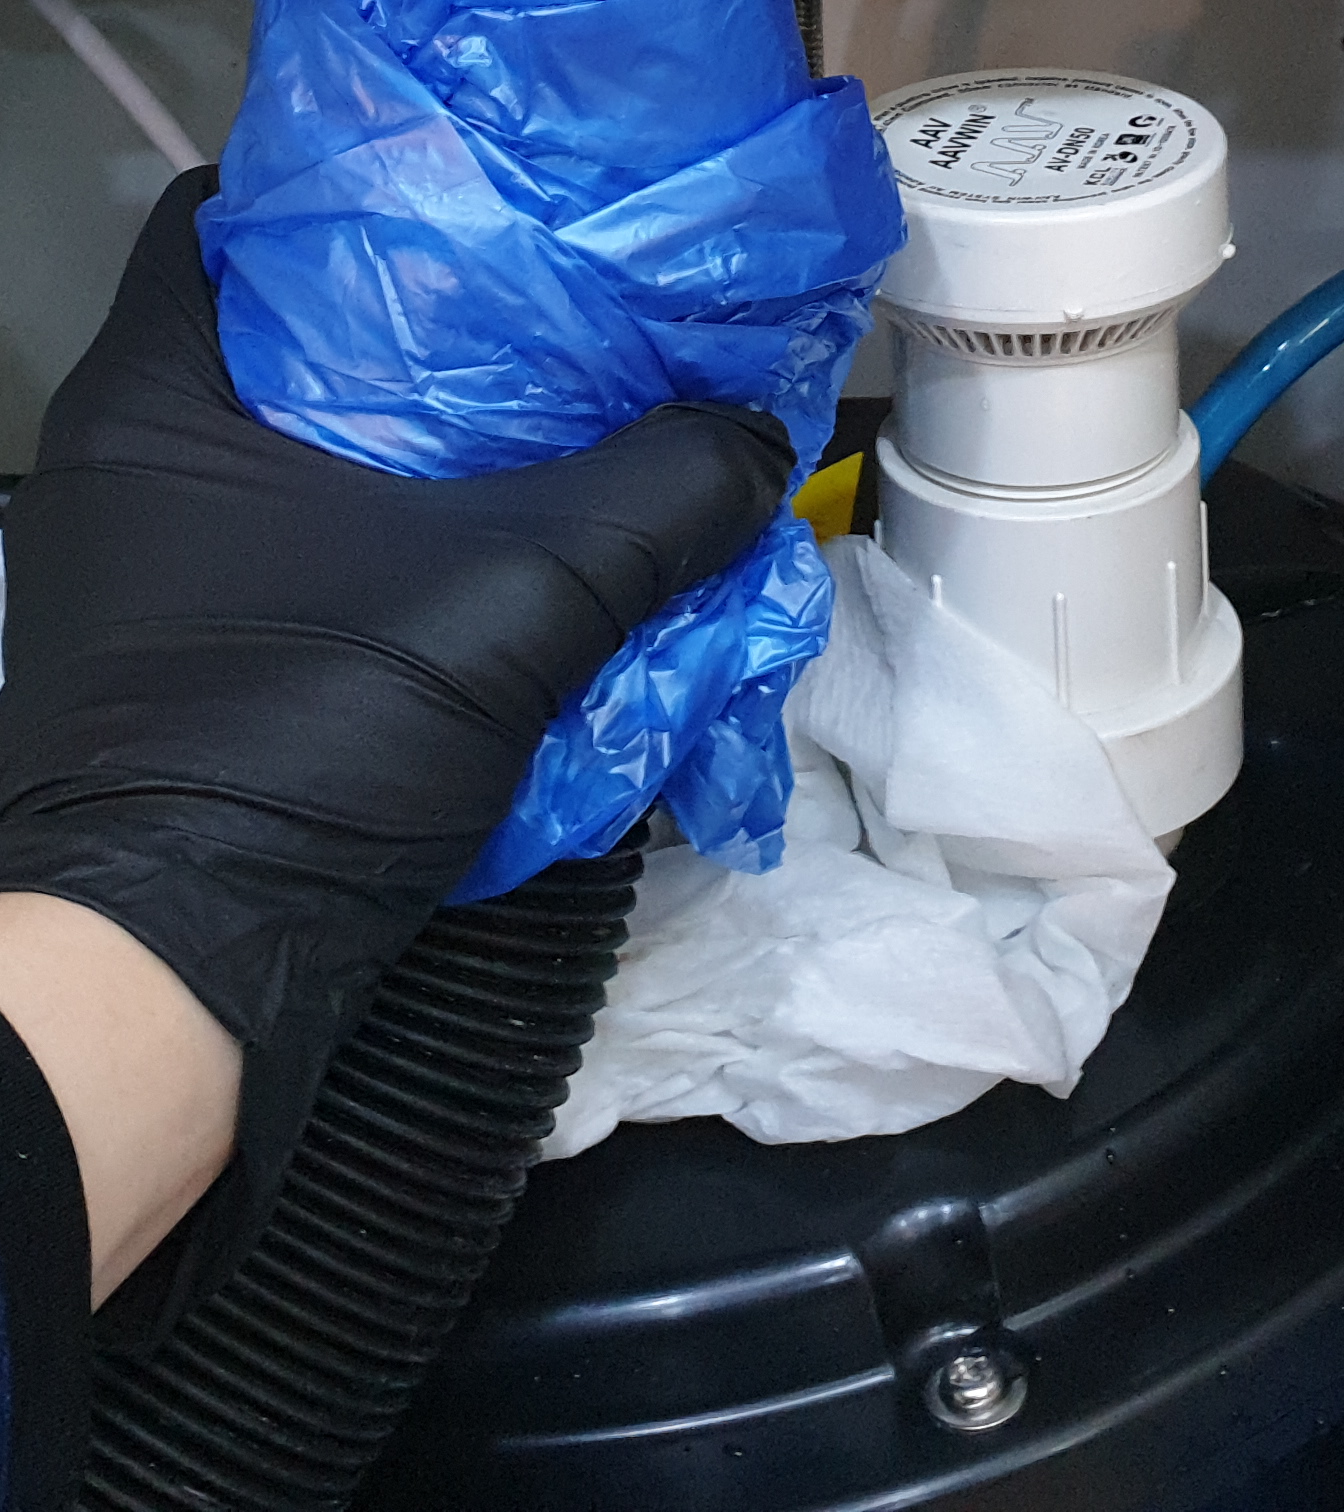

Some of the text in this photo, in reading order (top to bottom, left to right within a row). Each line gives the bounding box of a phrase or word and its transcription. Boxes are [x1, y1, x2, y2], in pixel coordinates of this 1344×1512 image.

[909, 117, 953, 150] AAV
[928, 113, 997, 170] AAVWIN
[1044, 126, 1096, 173] AV-DN50
